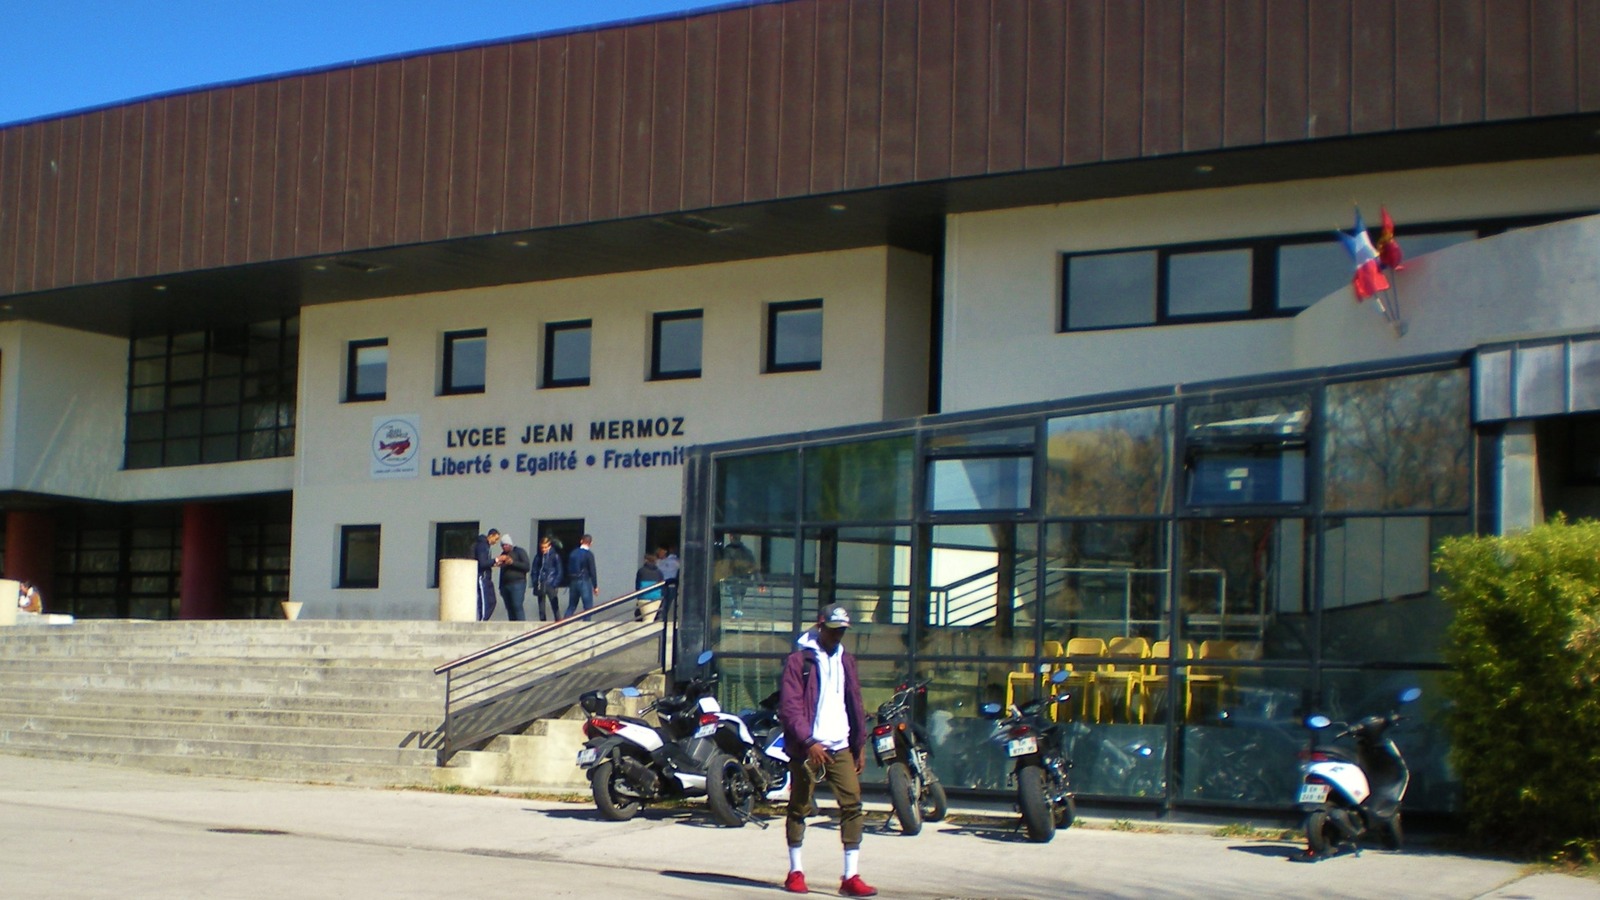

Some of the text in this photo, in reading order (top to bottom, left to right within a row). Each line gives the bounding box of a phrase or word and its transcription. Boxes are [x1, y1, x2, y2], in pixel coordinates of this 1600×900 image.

[446, 416, 685, 448] LYCEE JEAN MERMOZ
[431, 446, 684, 476] Liberté Egalité Fraternit
